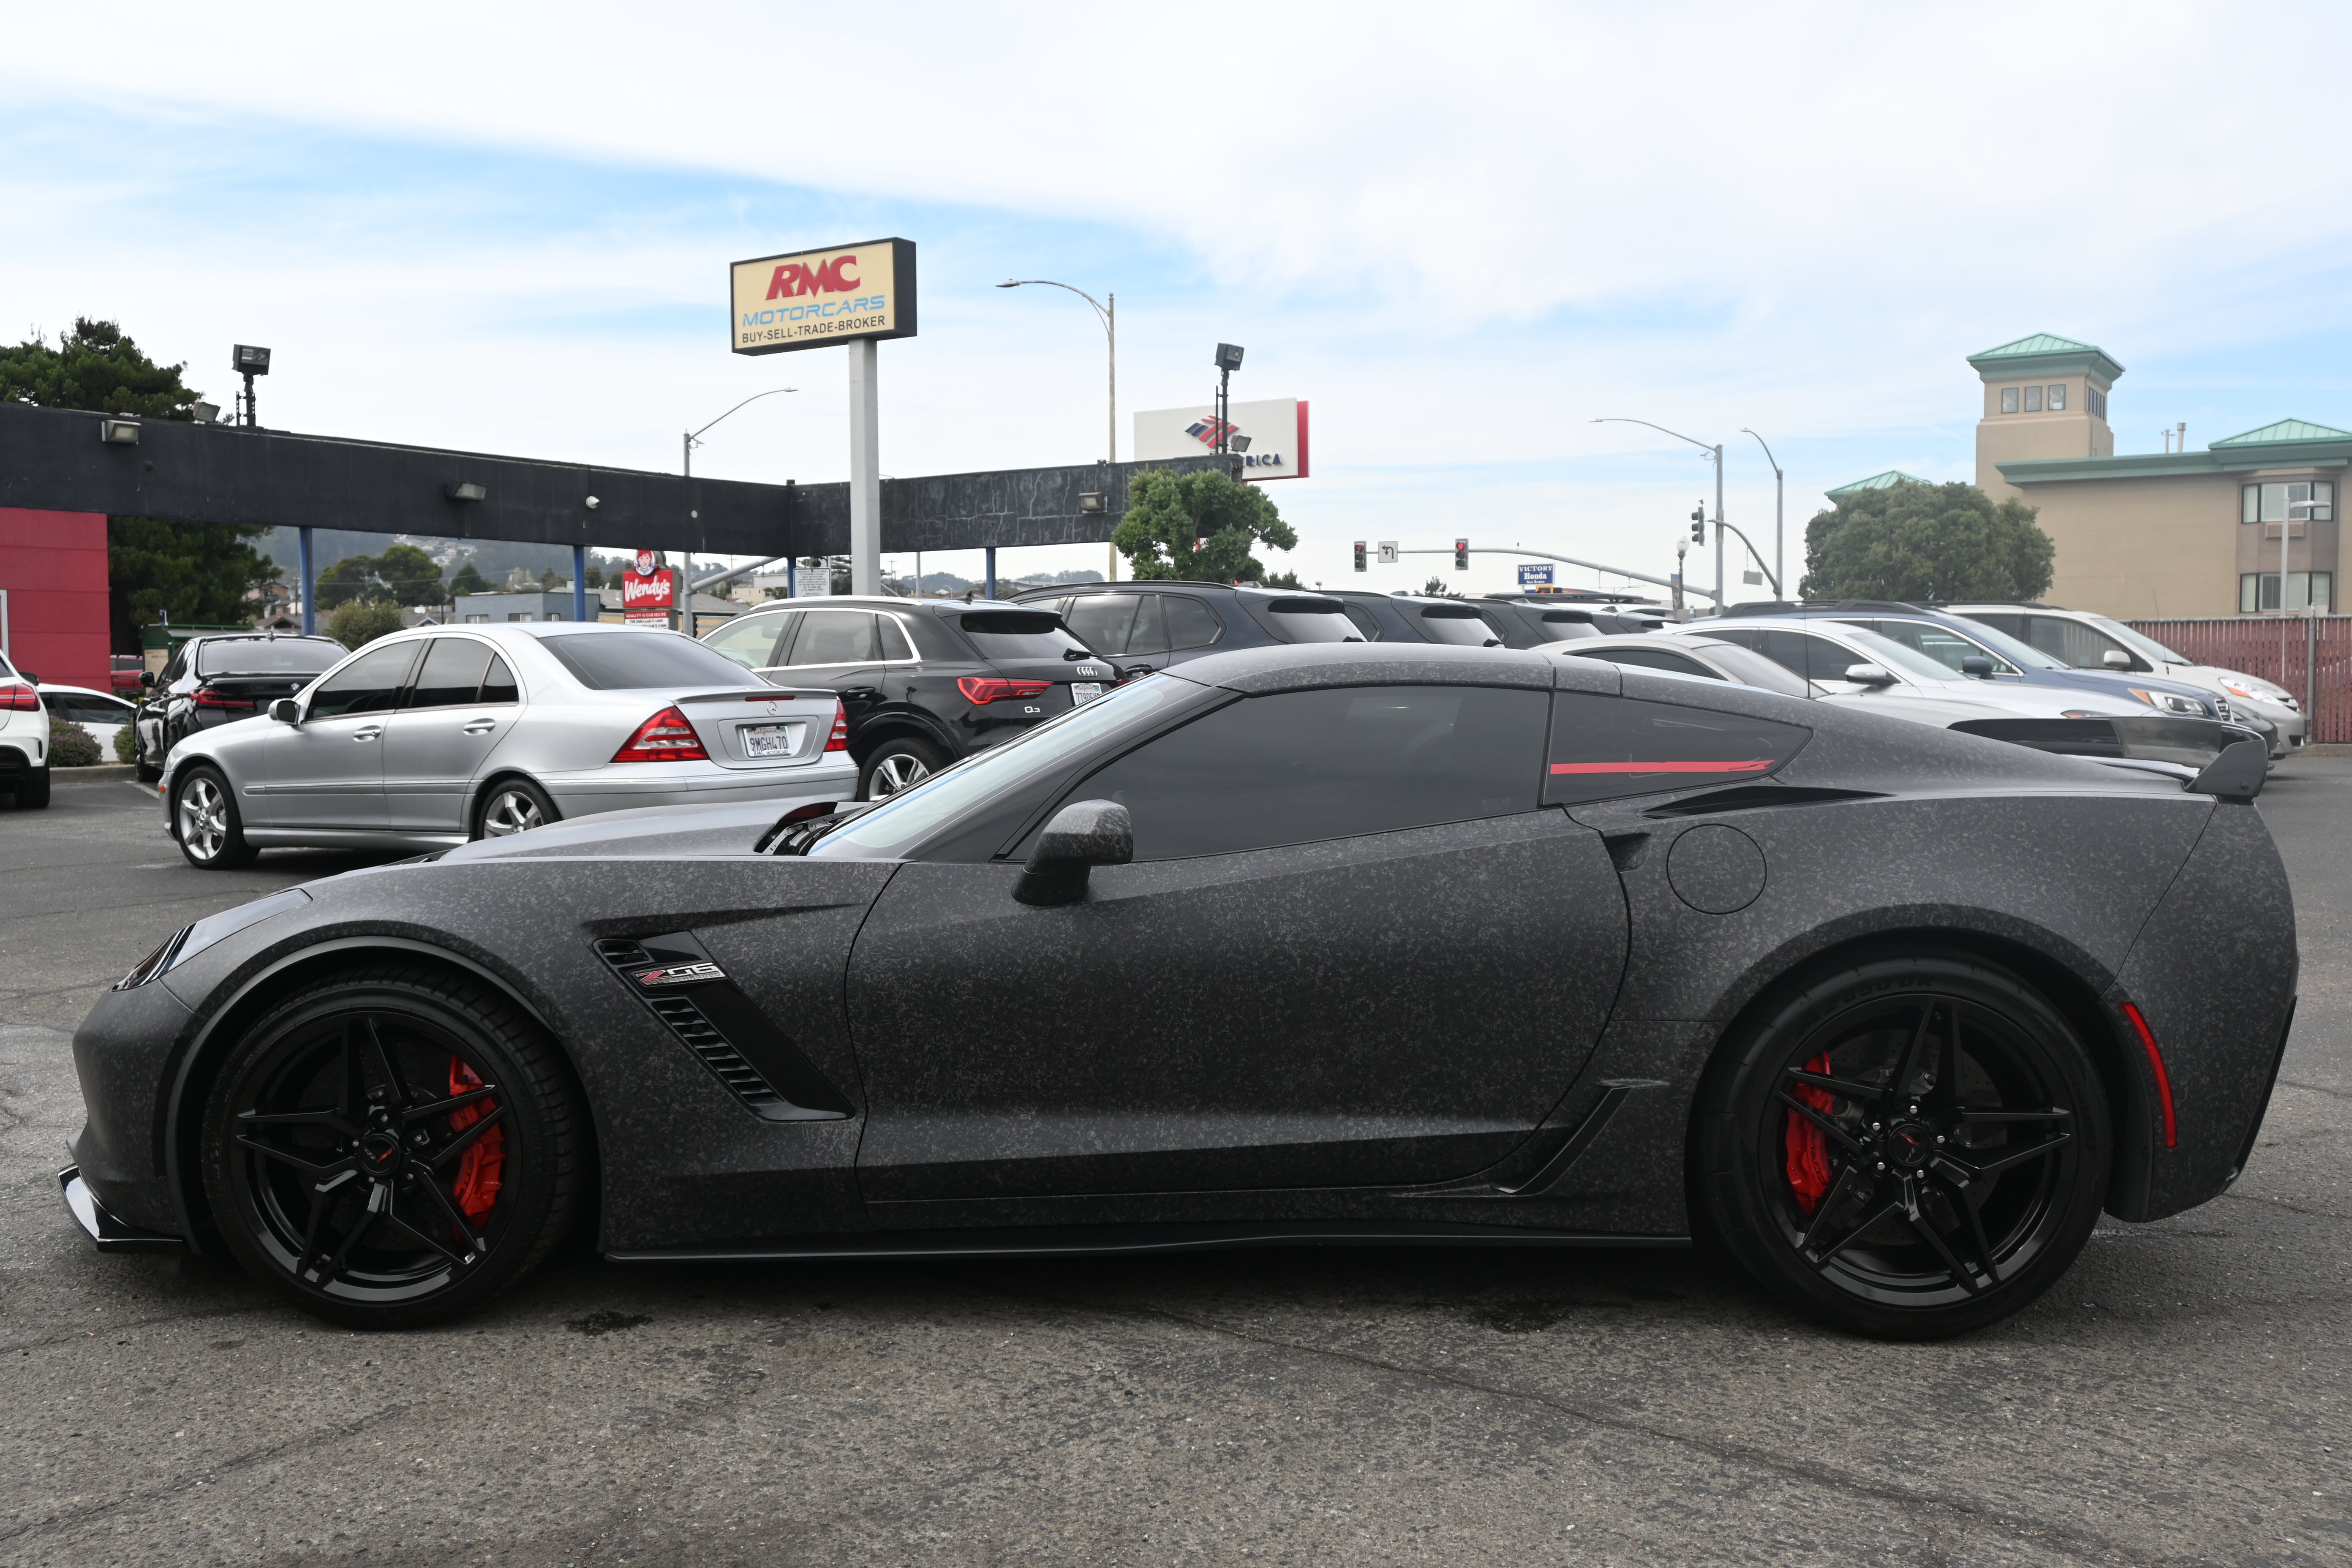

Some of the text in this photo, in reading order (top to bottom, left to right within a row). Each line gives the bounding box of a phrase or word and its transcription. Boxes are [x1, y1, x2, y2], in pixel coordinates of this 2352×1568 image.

[765, 255, 860, 301] RMC
[742, 294, 885, 327] MOTORCARS
[742, 315, 885, 343] BUY-SELL-TRADE-BROKER
[1245, 453, 1283, 467] RICA
[624, 575, 671, 602] Wendy's
[753, 728, 780, 736] California
[749, 735, 788, 751] 9MGH470
[635, 962, 719, 982] Z06
[642, 972, 721, 985] SUPERCHARGED
